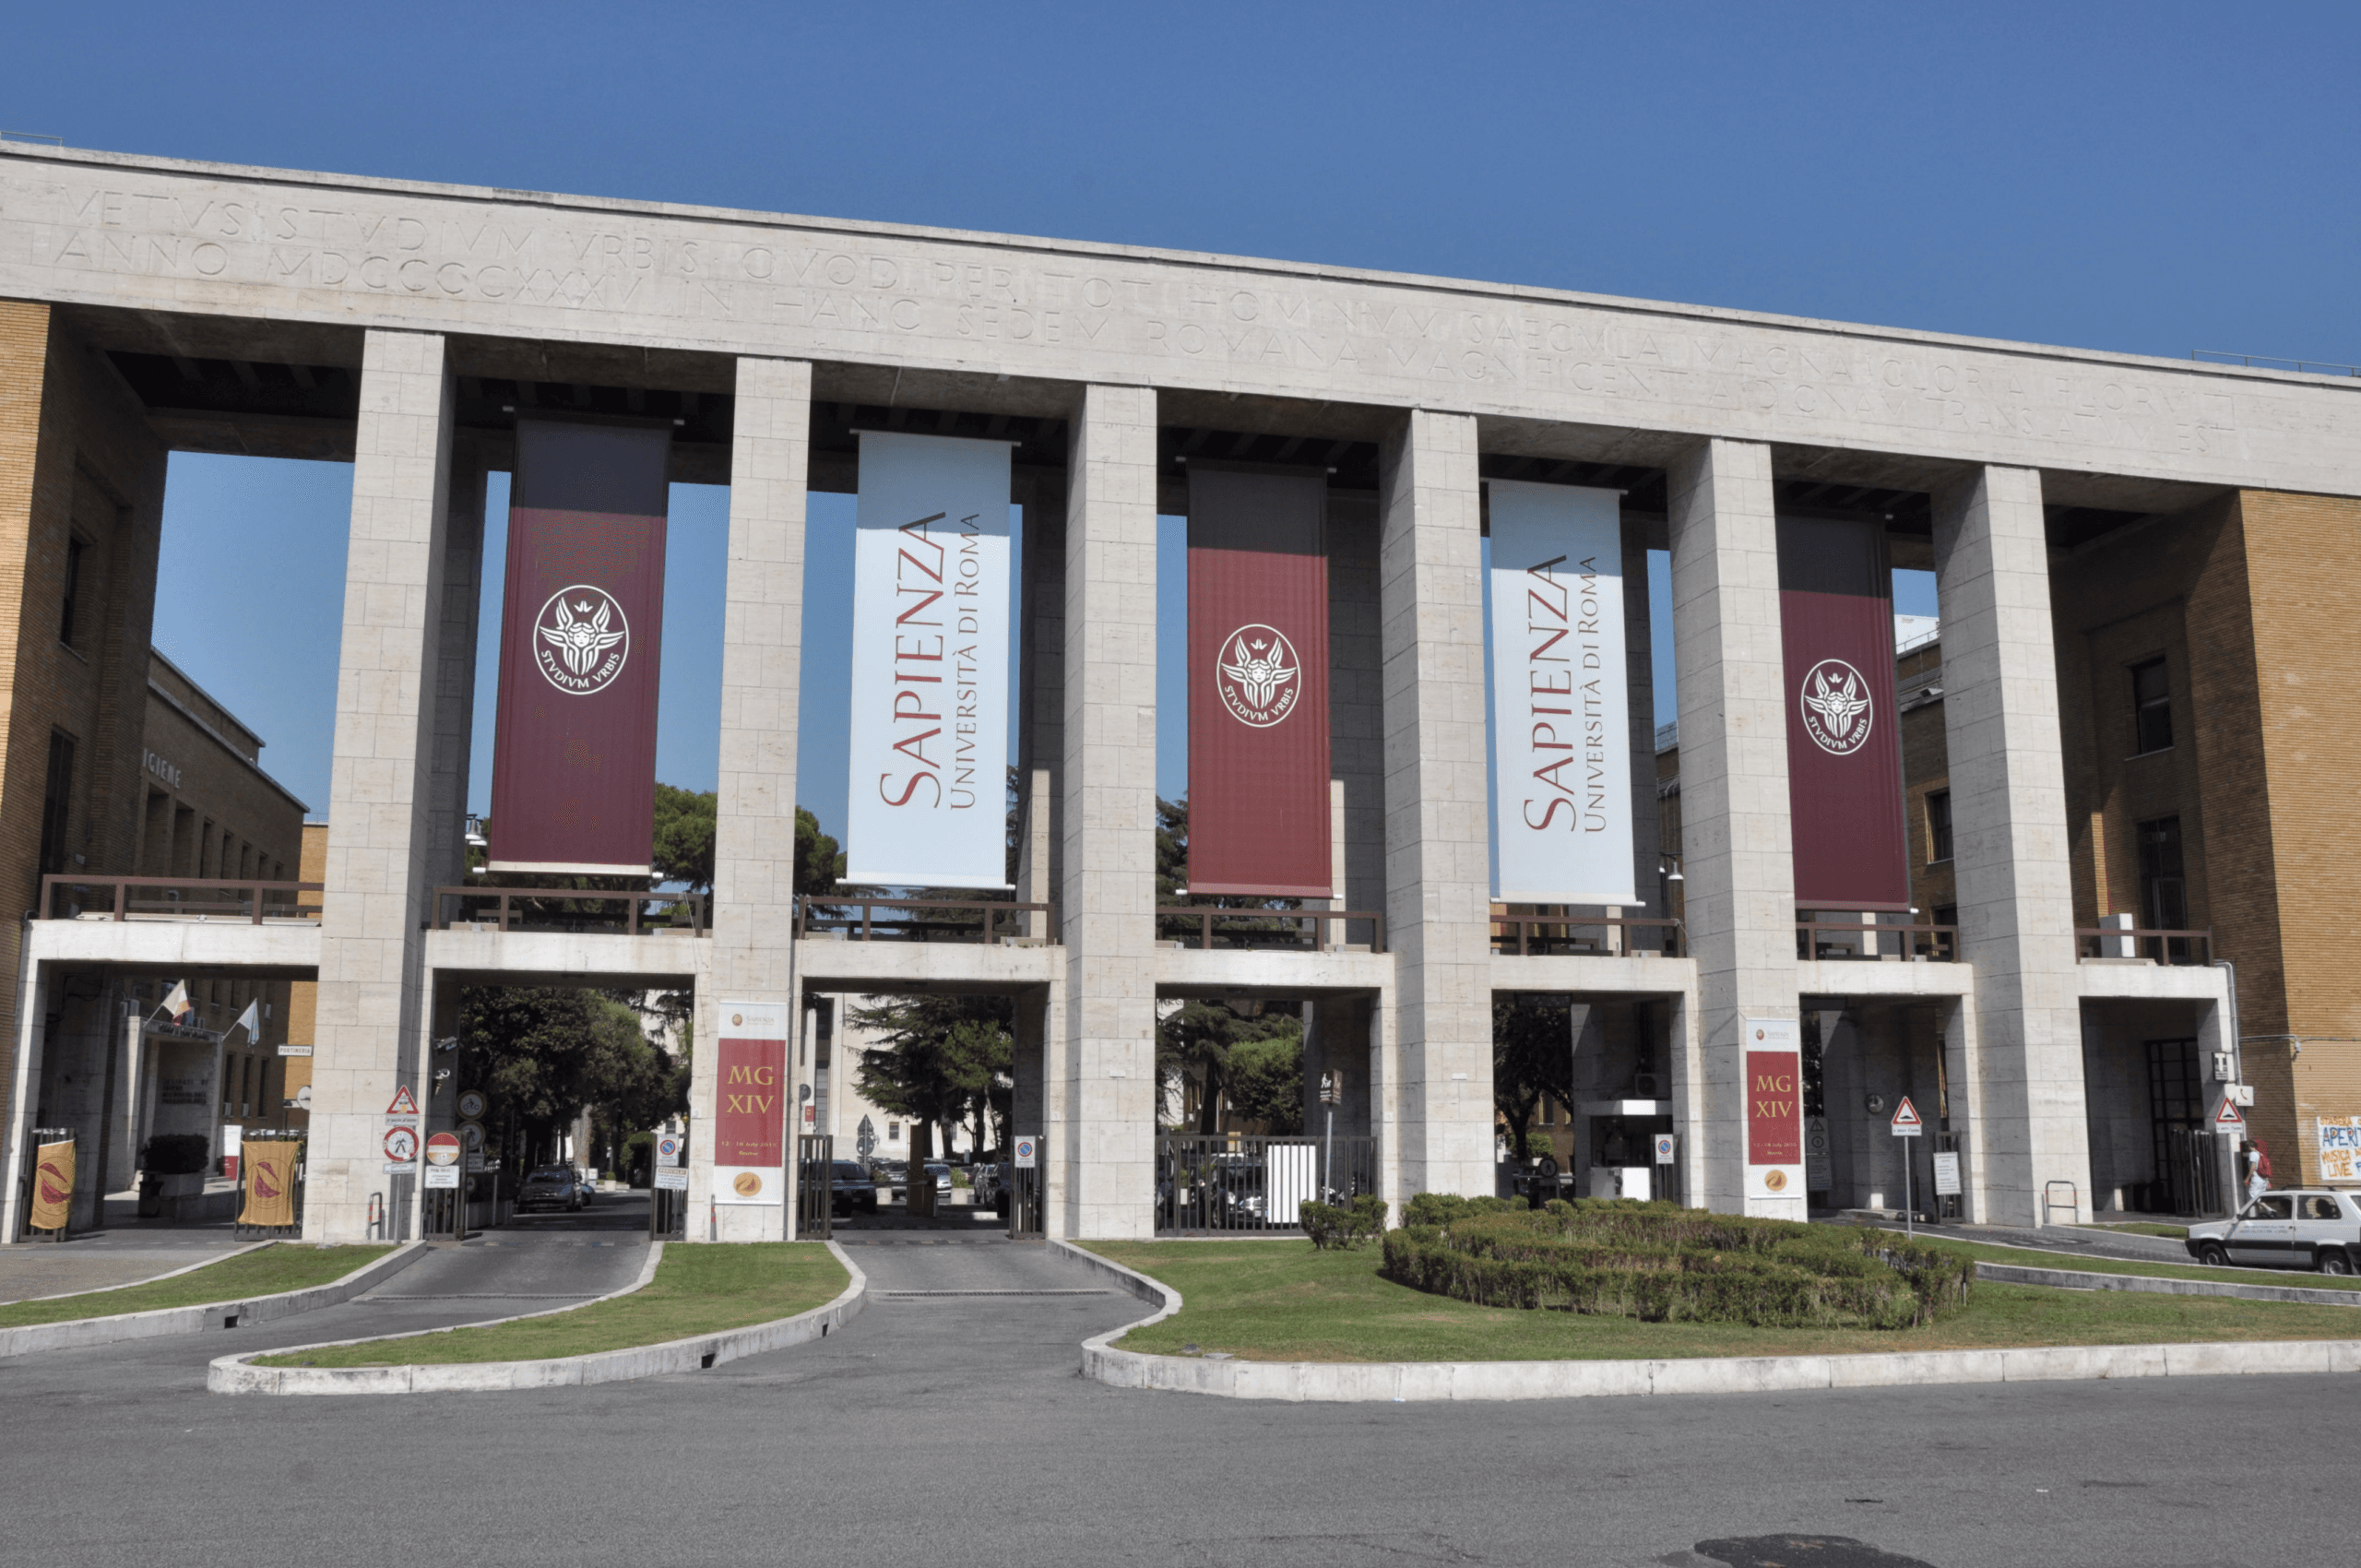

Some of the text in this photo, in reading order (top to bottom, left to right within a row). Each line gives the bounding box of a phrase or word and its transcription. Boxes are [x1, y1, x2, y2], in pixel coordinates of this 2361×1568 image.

[60, 186, 246, 237] VETVS
[276, 207, 535, 260] STVDIVM
[567, 232, 702, 276] VRBIS
[741, 246, 900, 291] QVOD
[934, 262, 1016, 303] PER
[1043, 271, 1151, 314] TOT
[1469, 315, 1665, 362] SAECVLA
[1693, 339, 1856, 381] MAGNA
[1880, 353, 2028, 399] GLORIA
[53, 231, 230, 277] ANNO
[265, 247, 644, 307] MDCCCCXXXV
[684, 281, 732, 316] IN
[771, 288, 920, 331] HANC
[956, 304, 1109, 344] SEDEM
[1147, 321, 1359, 368] ROMANA
[1752, 378, 1911, 419] DIGNAM
[540, 649, 621, 689] STVDIVM VRBIS
[880, 512, 946, 809] SAPIENZA
[951, 513, 979, 811] UNIVERSITÀ DI ROMA
[1224, 684, 1294, 722] STVDIVM VRBIS
[1524, 554, 1577, 832] SAPIENZA
[1577, 556, 1607, 834] UNIVERSITÀ DI ROMA
[1809, 716, 1868, 750] STVDIVM VRBIS
[727, 1065, 774, 1086] MG
[1755, 1075, 1792, 1093] MG
[726, 1095, 774, 1114] XIV
[1755, 1100, 1793, 1118] XIV
[2328, 1162, 2353, 1177] LIVE
